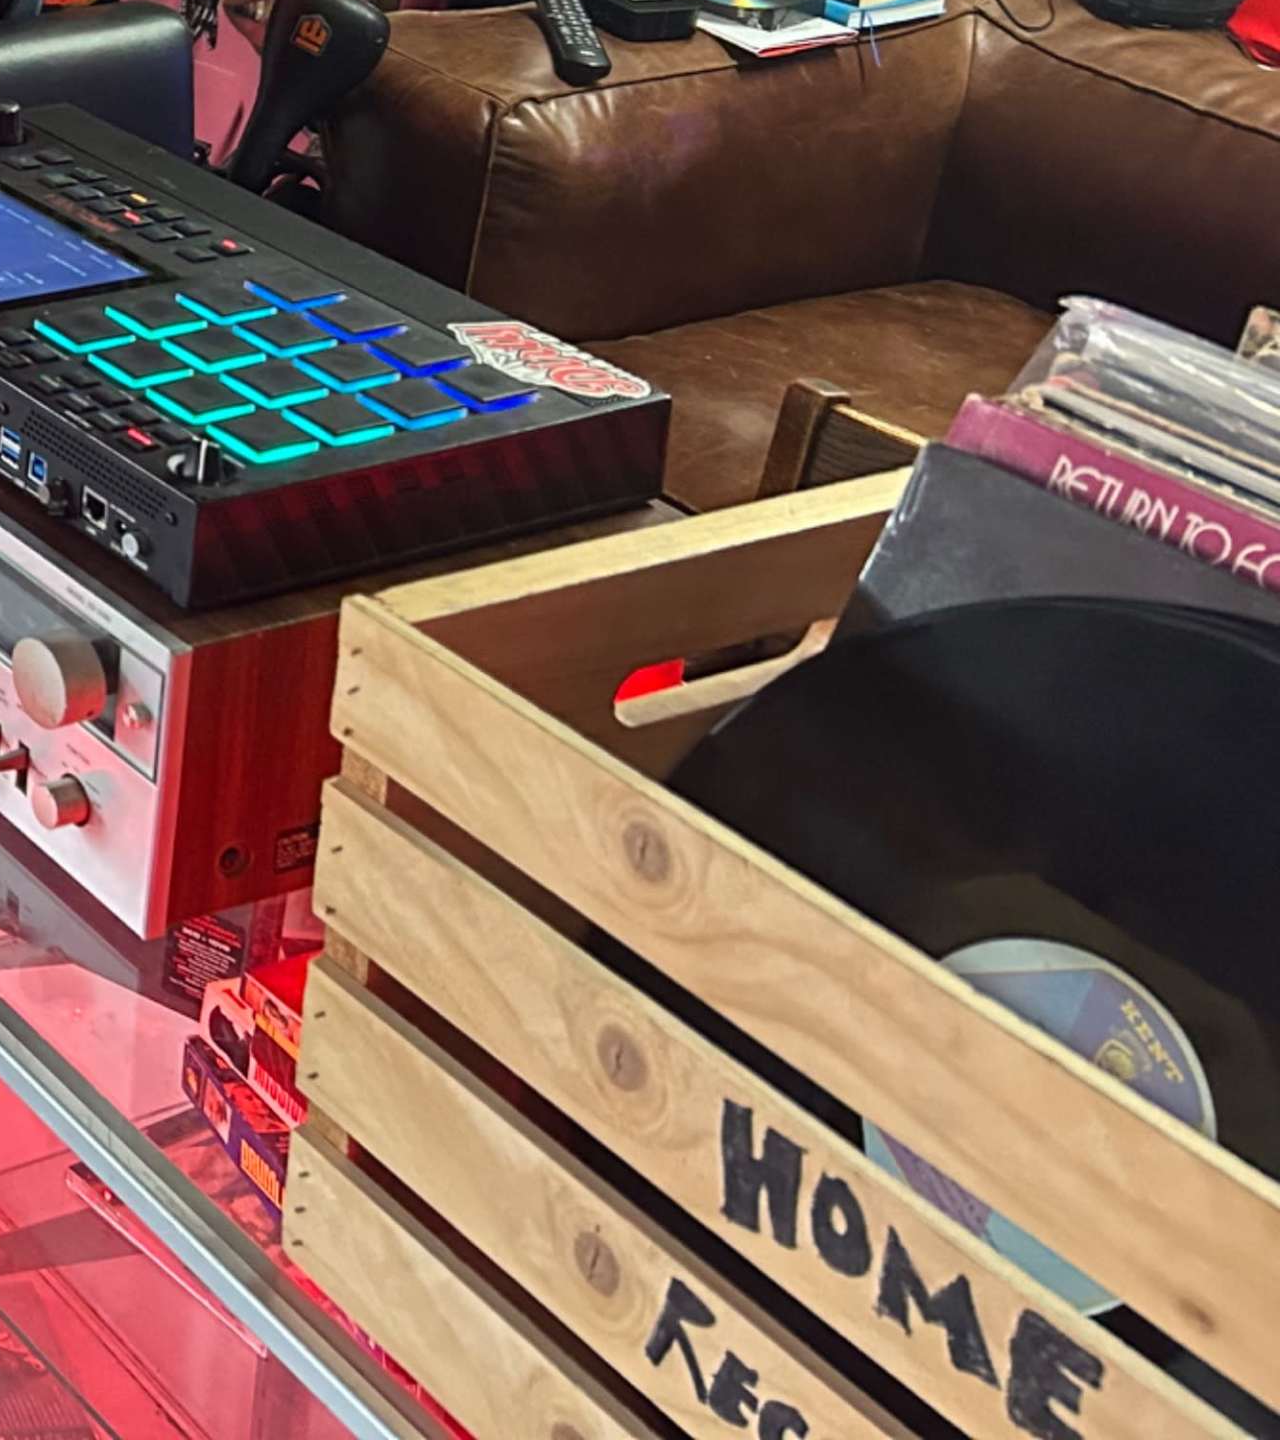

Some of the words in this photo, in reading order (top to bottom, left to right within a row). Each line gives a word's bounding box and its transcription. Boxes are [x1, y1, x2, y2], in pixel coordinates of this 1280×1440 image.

[1046, 453, 1180, 542] RETURN
[1180, 513, 1233, 565] TO
[1120, 998, 1185, 1084] KENT
[720, 1096, 1106, 1440] HOME
[644, 1276, 812, 1440] REC
